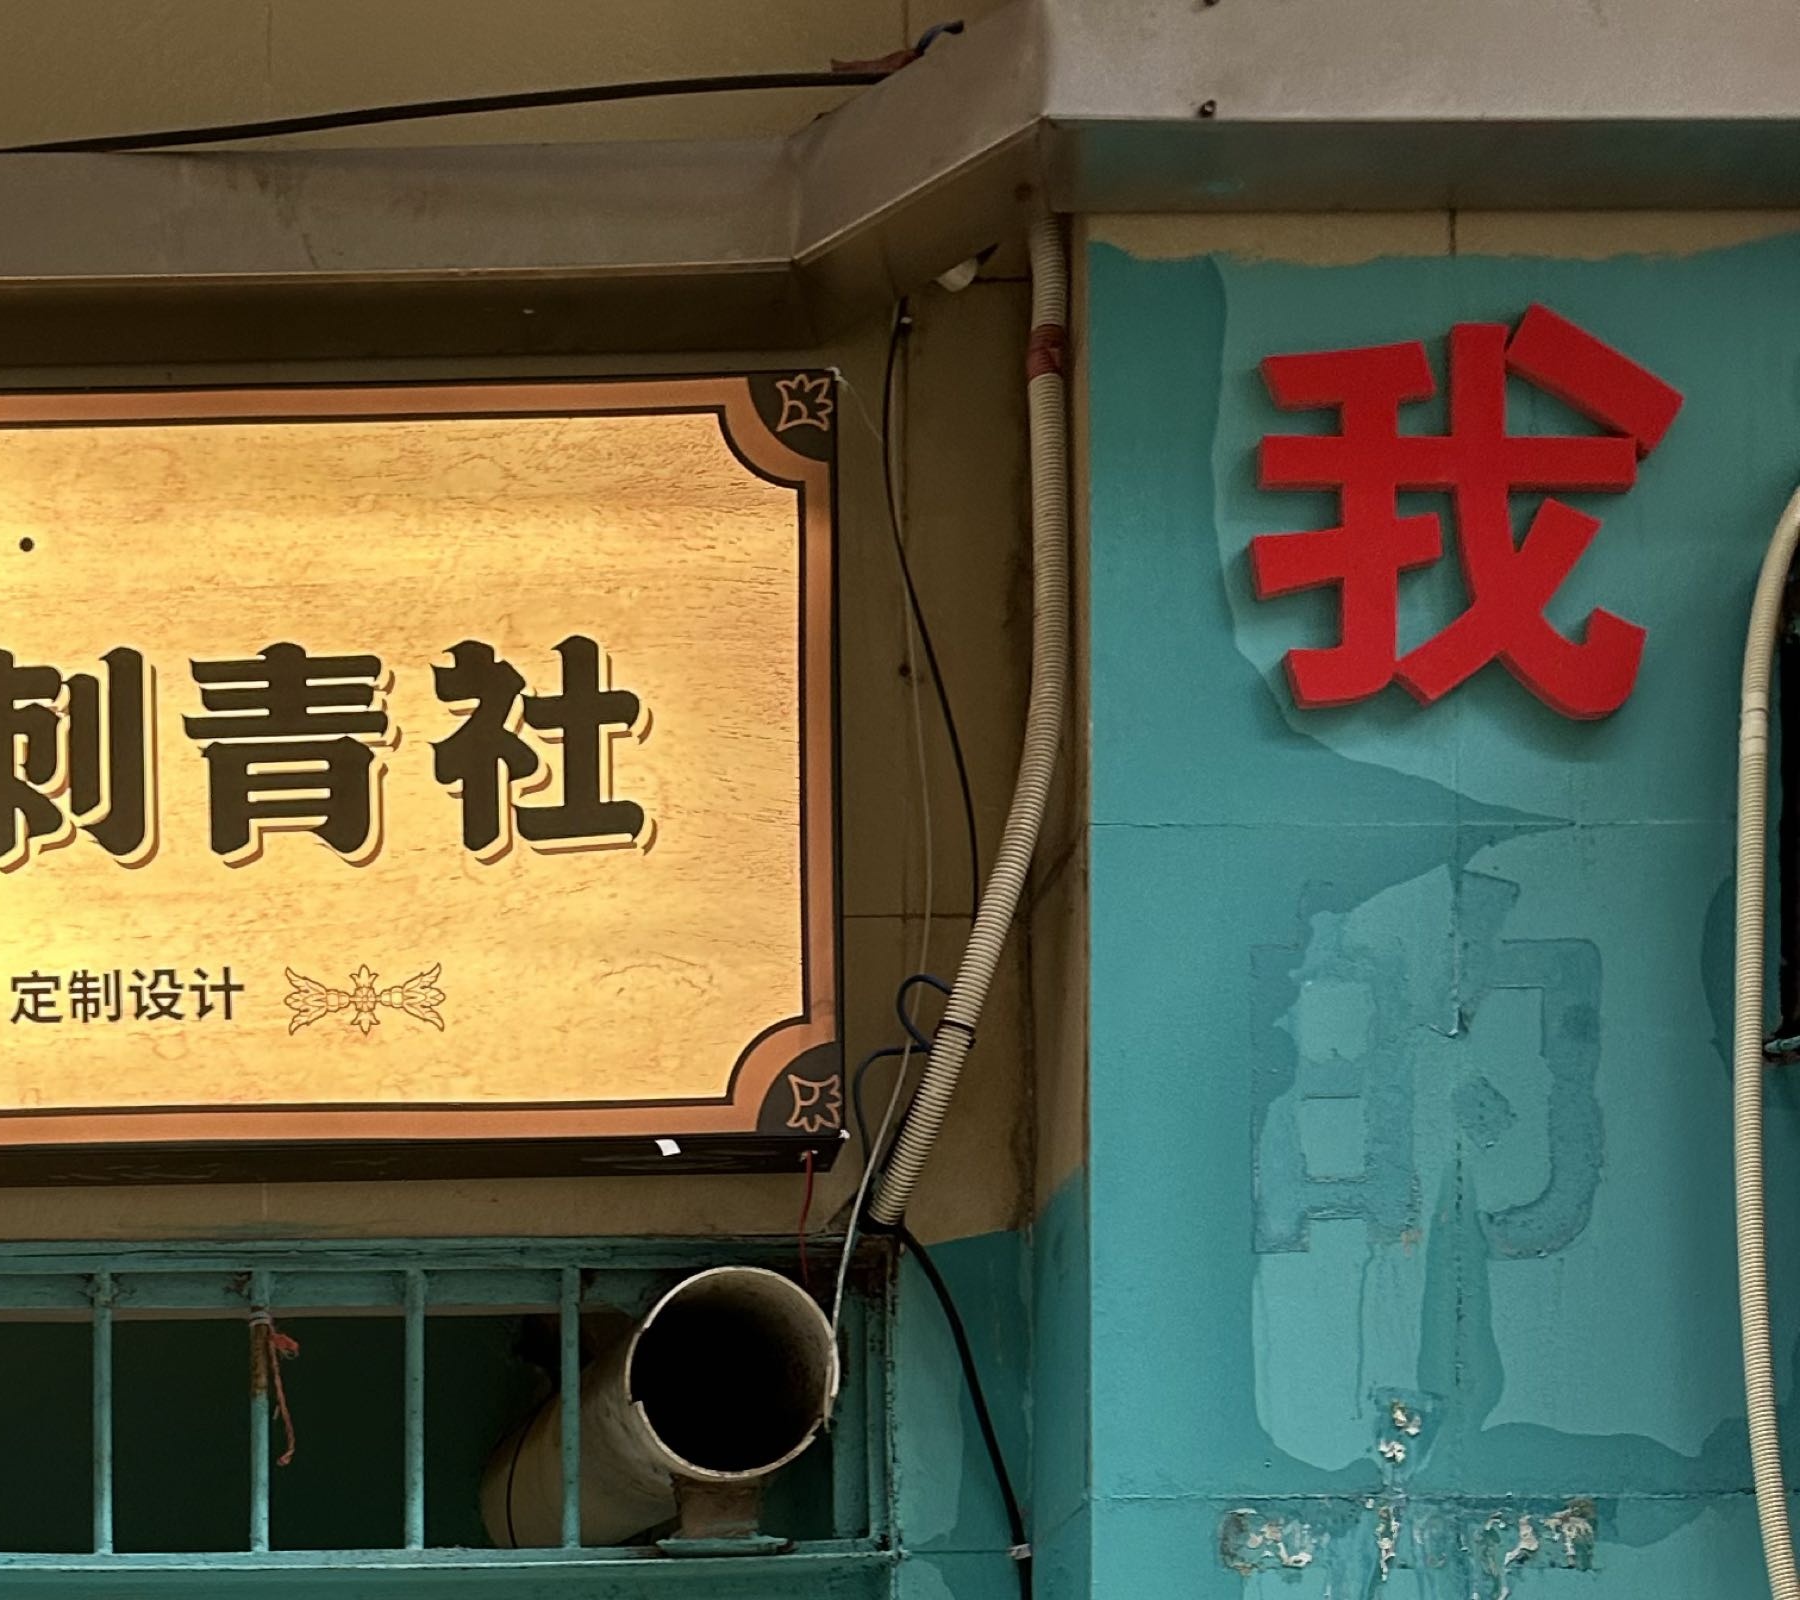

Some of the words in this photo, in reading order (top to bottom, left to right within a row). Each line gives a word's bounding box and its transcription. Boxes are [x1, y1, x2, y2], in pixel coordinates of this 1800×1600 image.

[1250, 302, 1684, 720] 我
[9, 965, 245, 1025] 定制设计
